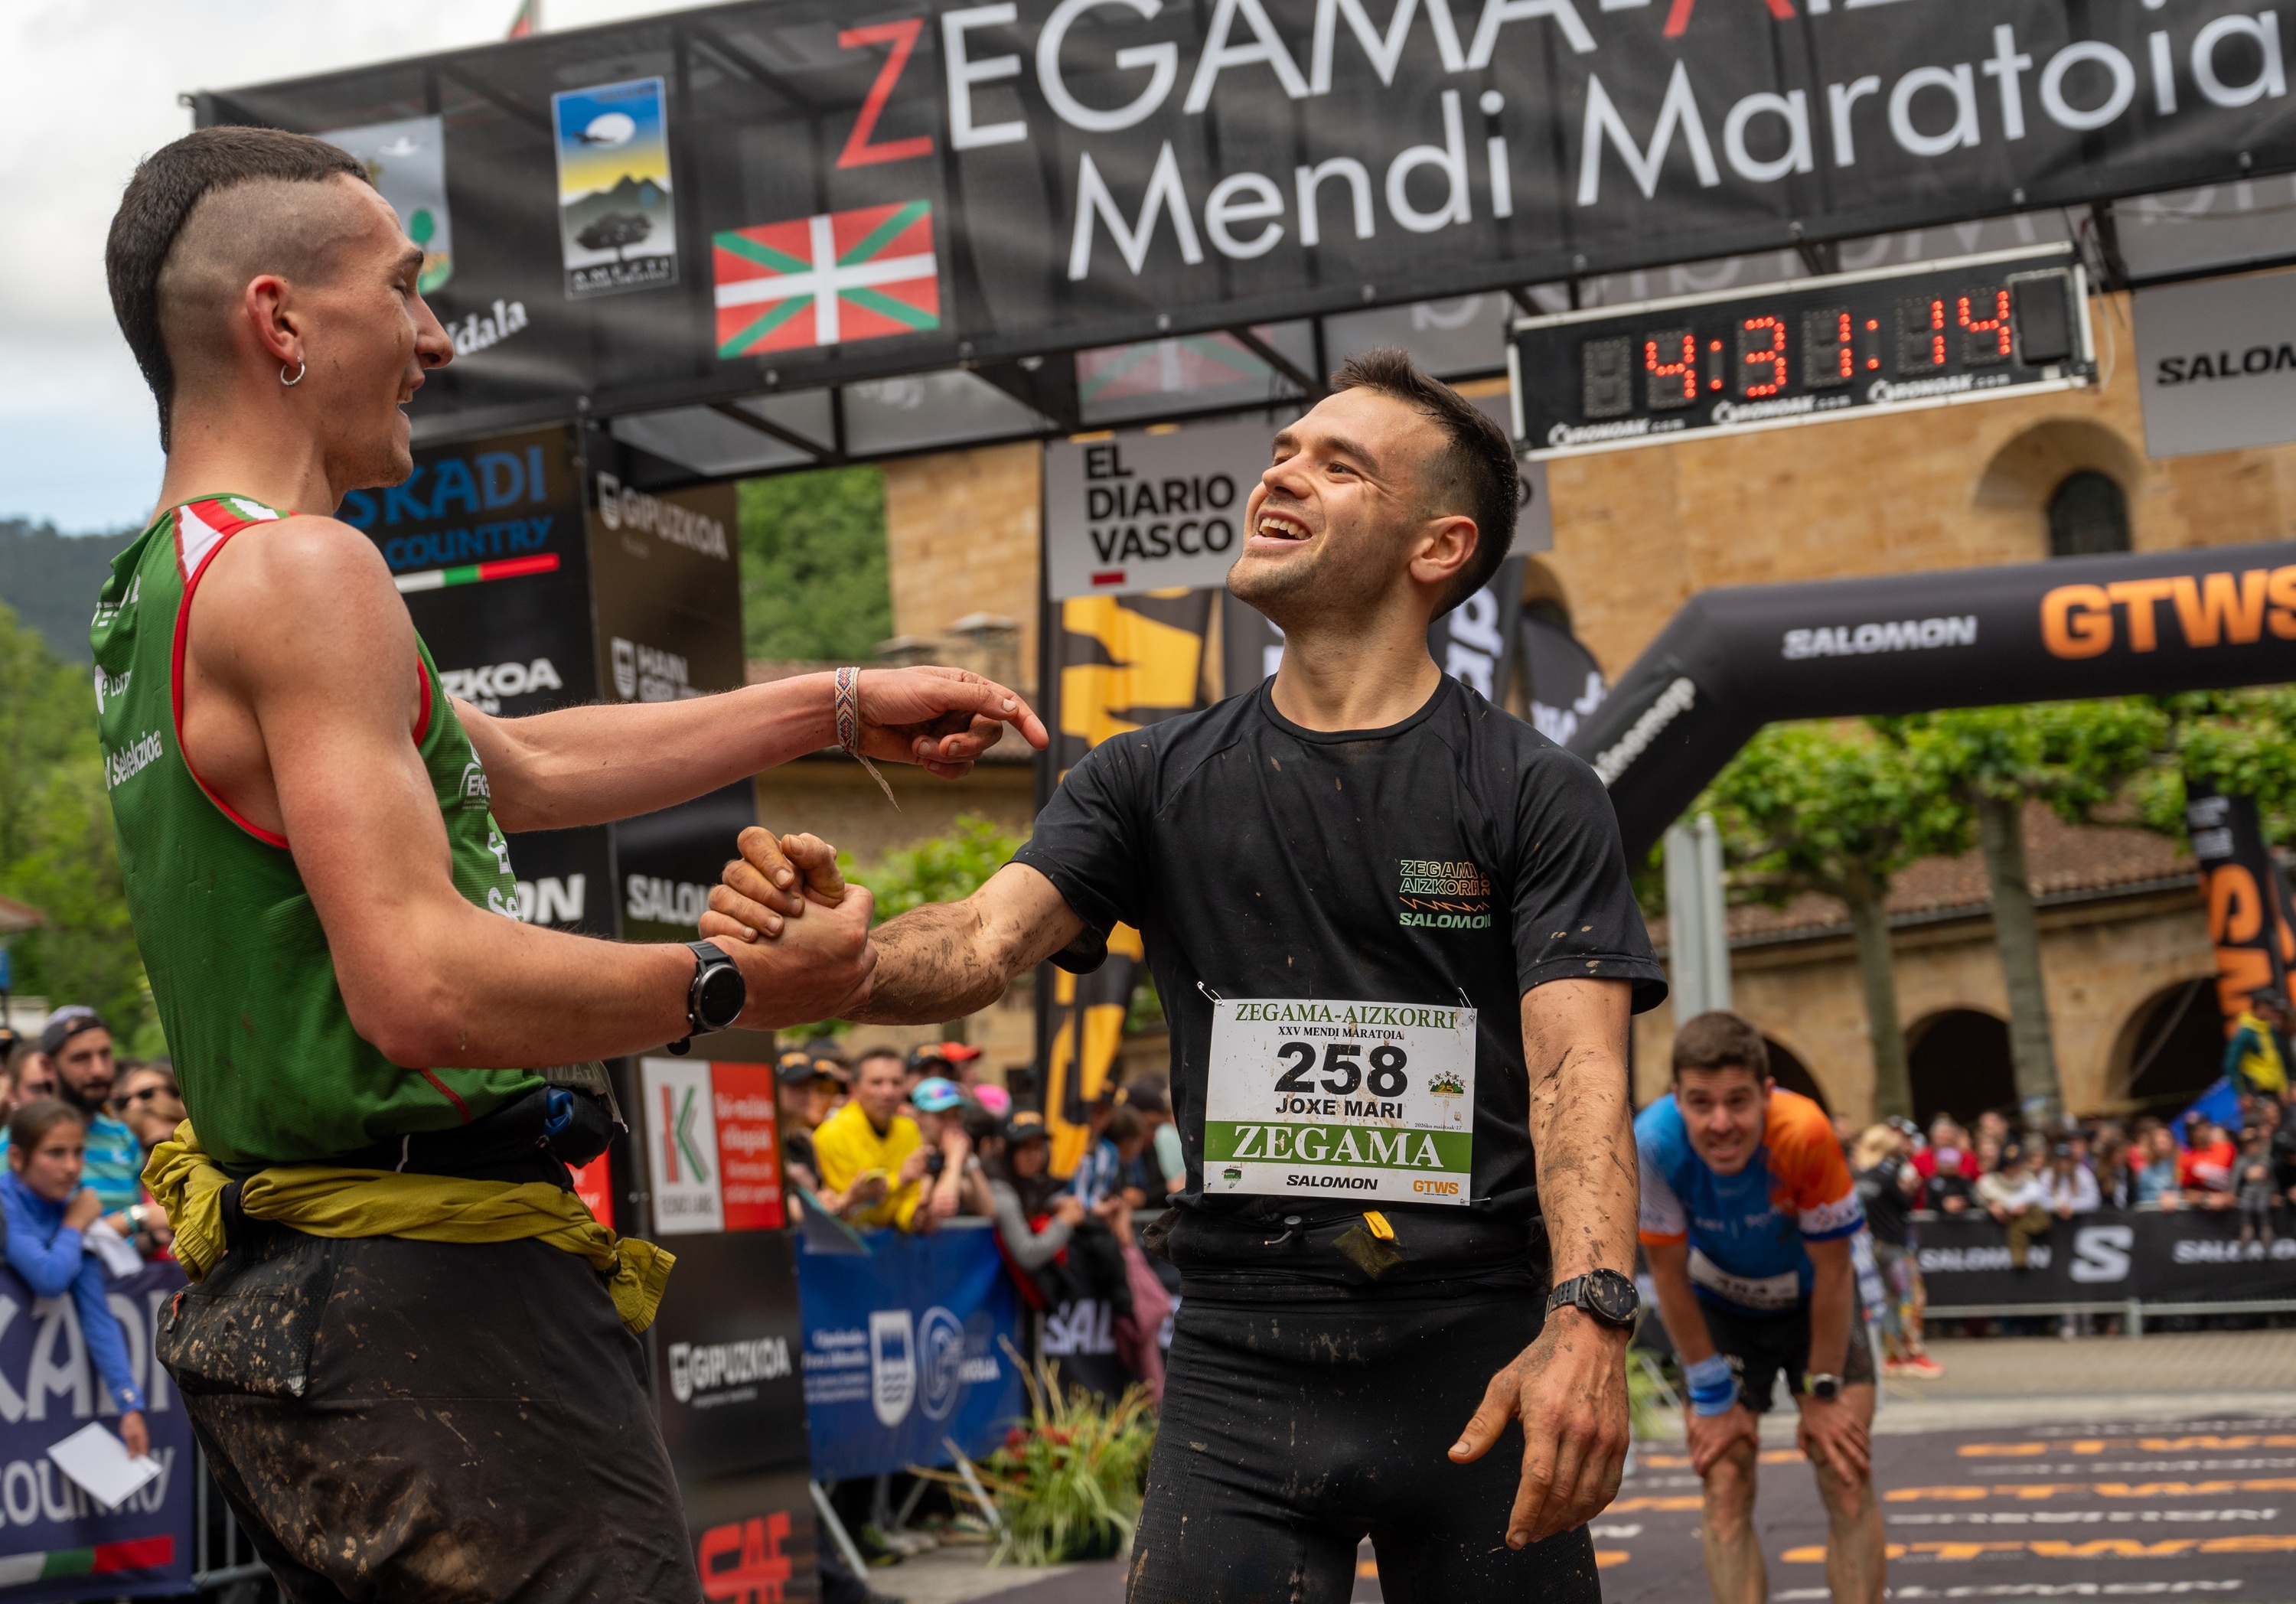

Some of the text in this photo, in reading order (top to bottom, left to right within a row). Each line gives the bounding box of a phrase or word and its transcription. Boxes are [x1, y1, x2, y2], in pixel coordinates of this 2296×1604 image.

[1068, 0, 2288, 282] Mendi Maratoia
[1645, 289, 2013, 399] 4:31:14
[1084, 443, 1133, 479] EL
[1087, 474, 1236, 523] DIARIO
[385, 515, 555, 570] COUNTRY
[1090, 520, 1234, 565] VASCO
[1782, 615, 1978, 660] SALOMON
[113, 729, 163, 786] Selekzioa
[1399, 912, 1492, 929] SALOMON
[1234, 1002, 1457, 1030] ZEGAMA-AIZKORRI
[1278, 1026, 1403, 1040] XXV MENDI MARATOIA
[1274, 1042, 1408, 1097] 258
[1275, 1098, 1404, 1120] JOXE MARI
[1231, 1125, 1444, 1168] ZEGAMA
[1286, 1174, 1459, 1195] SALOMON GTWS
[1918, 1244, 2053, 1273] SALOMN
[2068, 1224, 2135, 1283] S
